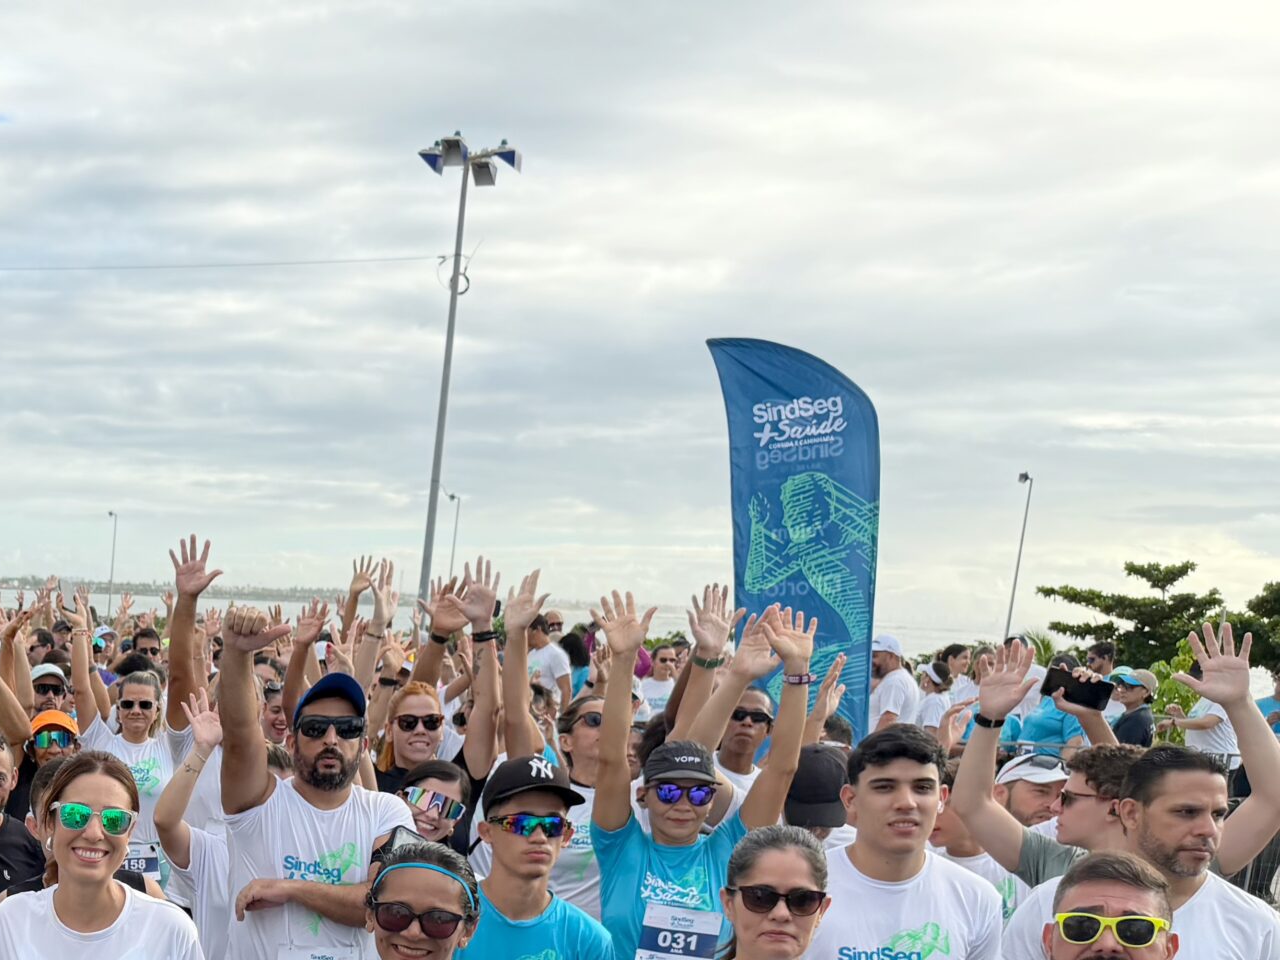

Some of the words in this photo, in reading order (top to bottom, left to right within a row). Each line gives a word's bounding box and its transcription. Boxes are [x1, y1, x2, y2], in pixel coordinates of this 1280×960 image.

[753, 396, 843, 424] SindSeg
[122, 858, 146, 871] 158
[657, 930, 698, 951] 031
